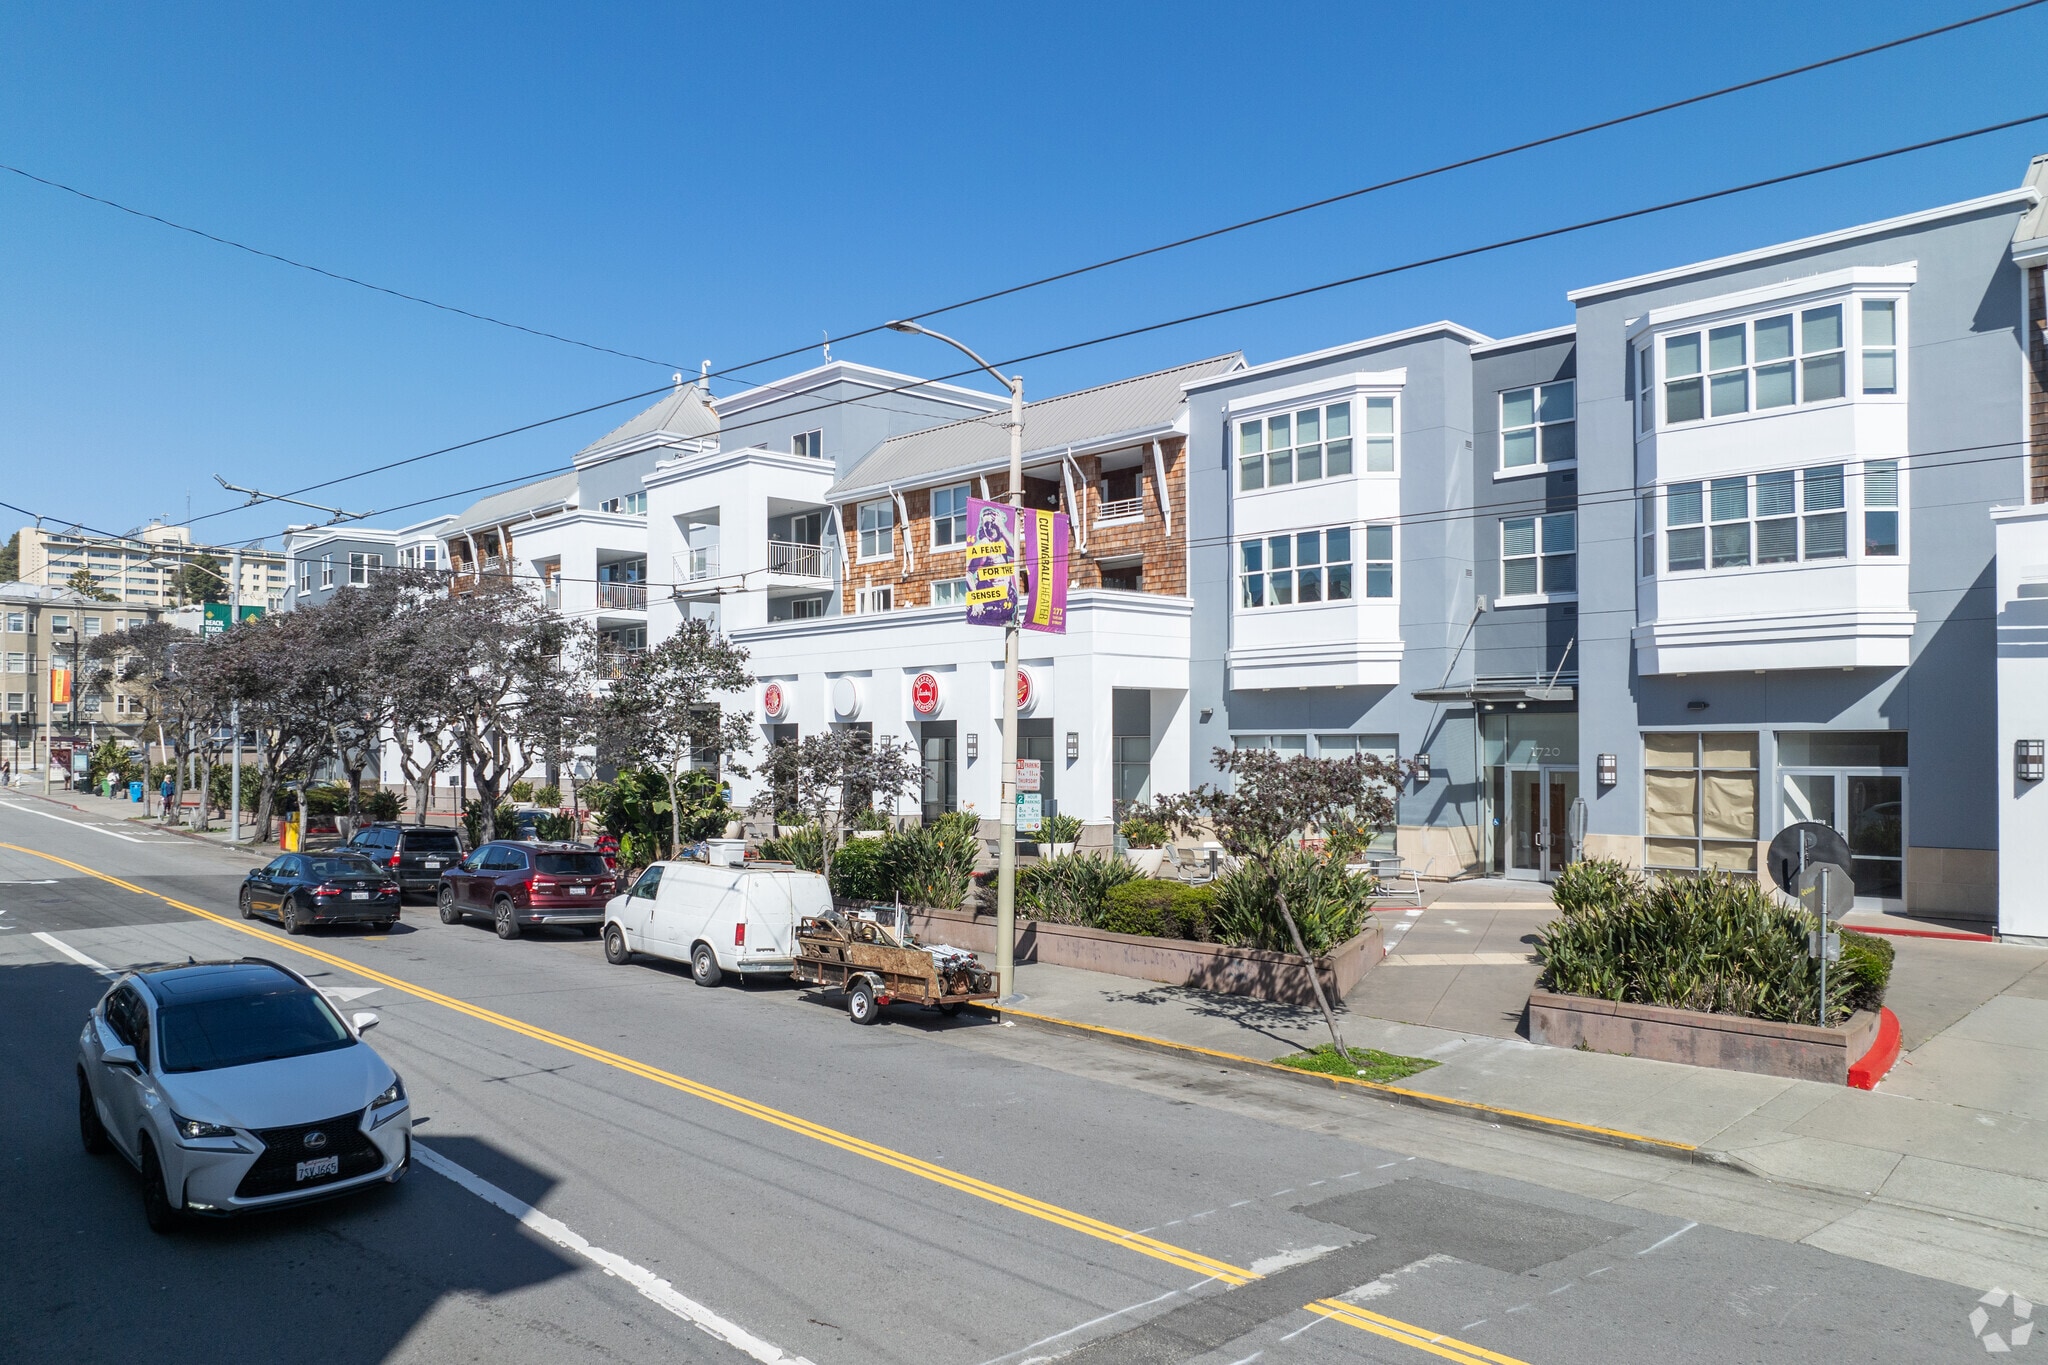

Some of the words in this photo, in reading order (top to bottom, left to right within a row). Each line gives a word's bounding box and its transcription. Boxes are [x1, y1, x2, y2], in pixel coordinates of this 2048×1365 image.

[971, 547, 977, 555] A
[980, 545, 1002, 554] FEAST
[982, 567, 999, 576] FOR
[1001, 566, 1013, 575] THE
[971, 590, 1001, 600] SENSES
[1531, 747, 1560, 760] 1720
[1018, 795, 1024, 803] 2
